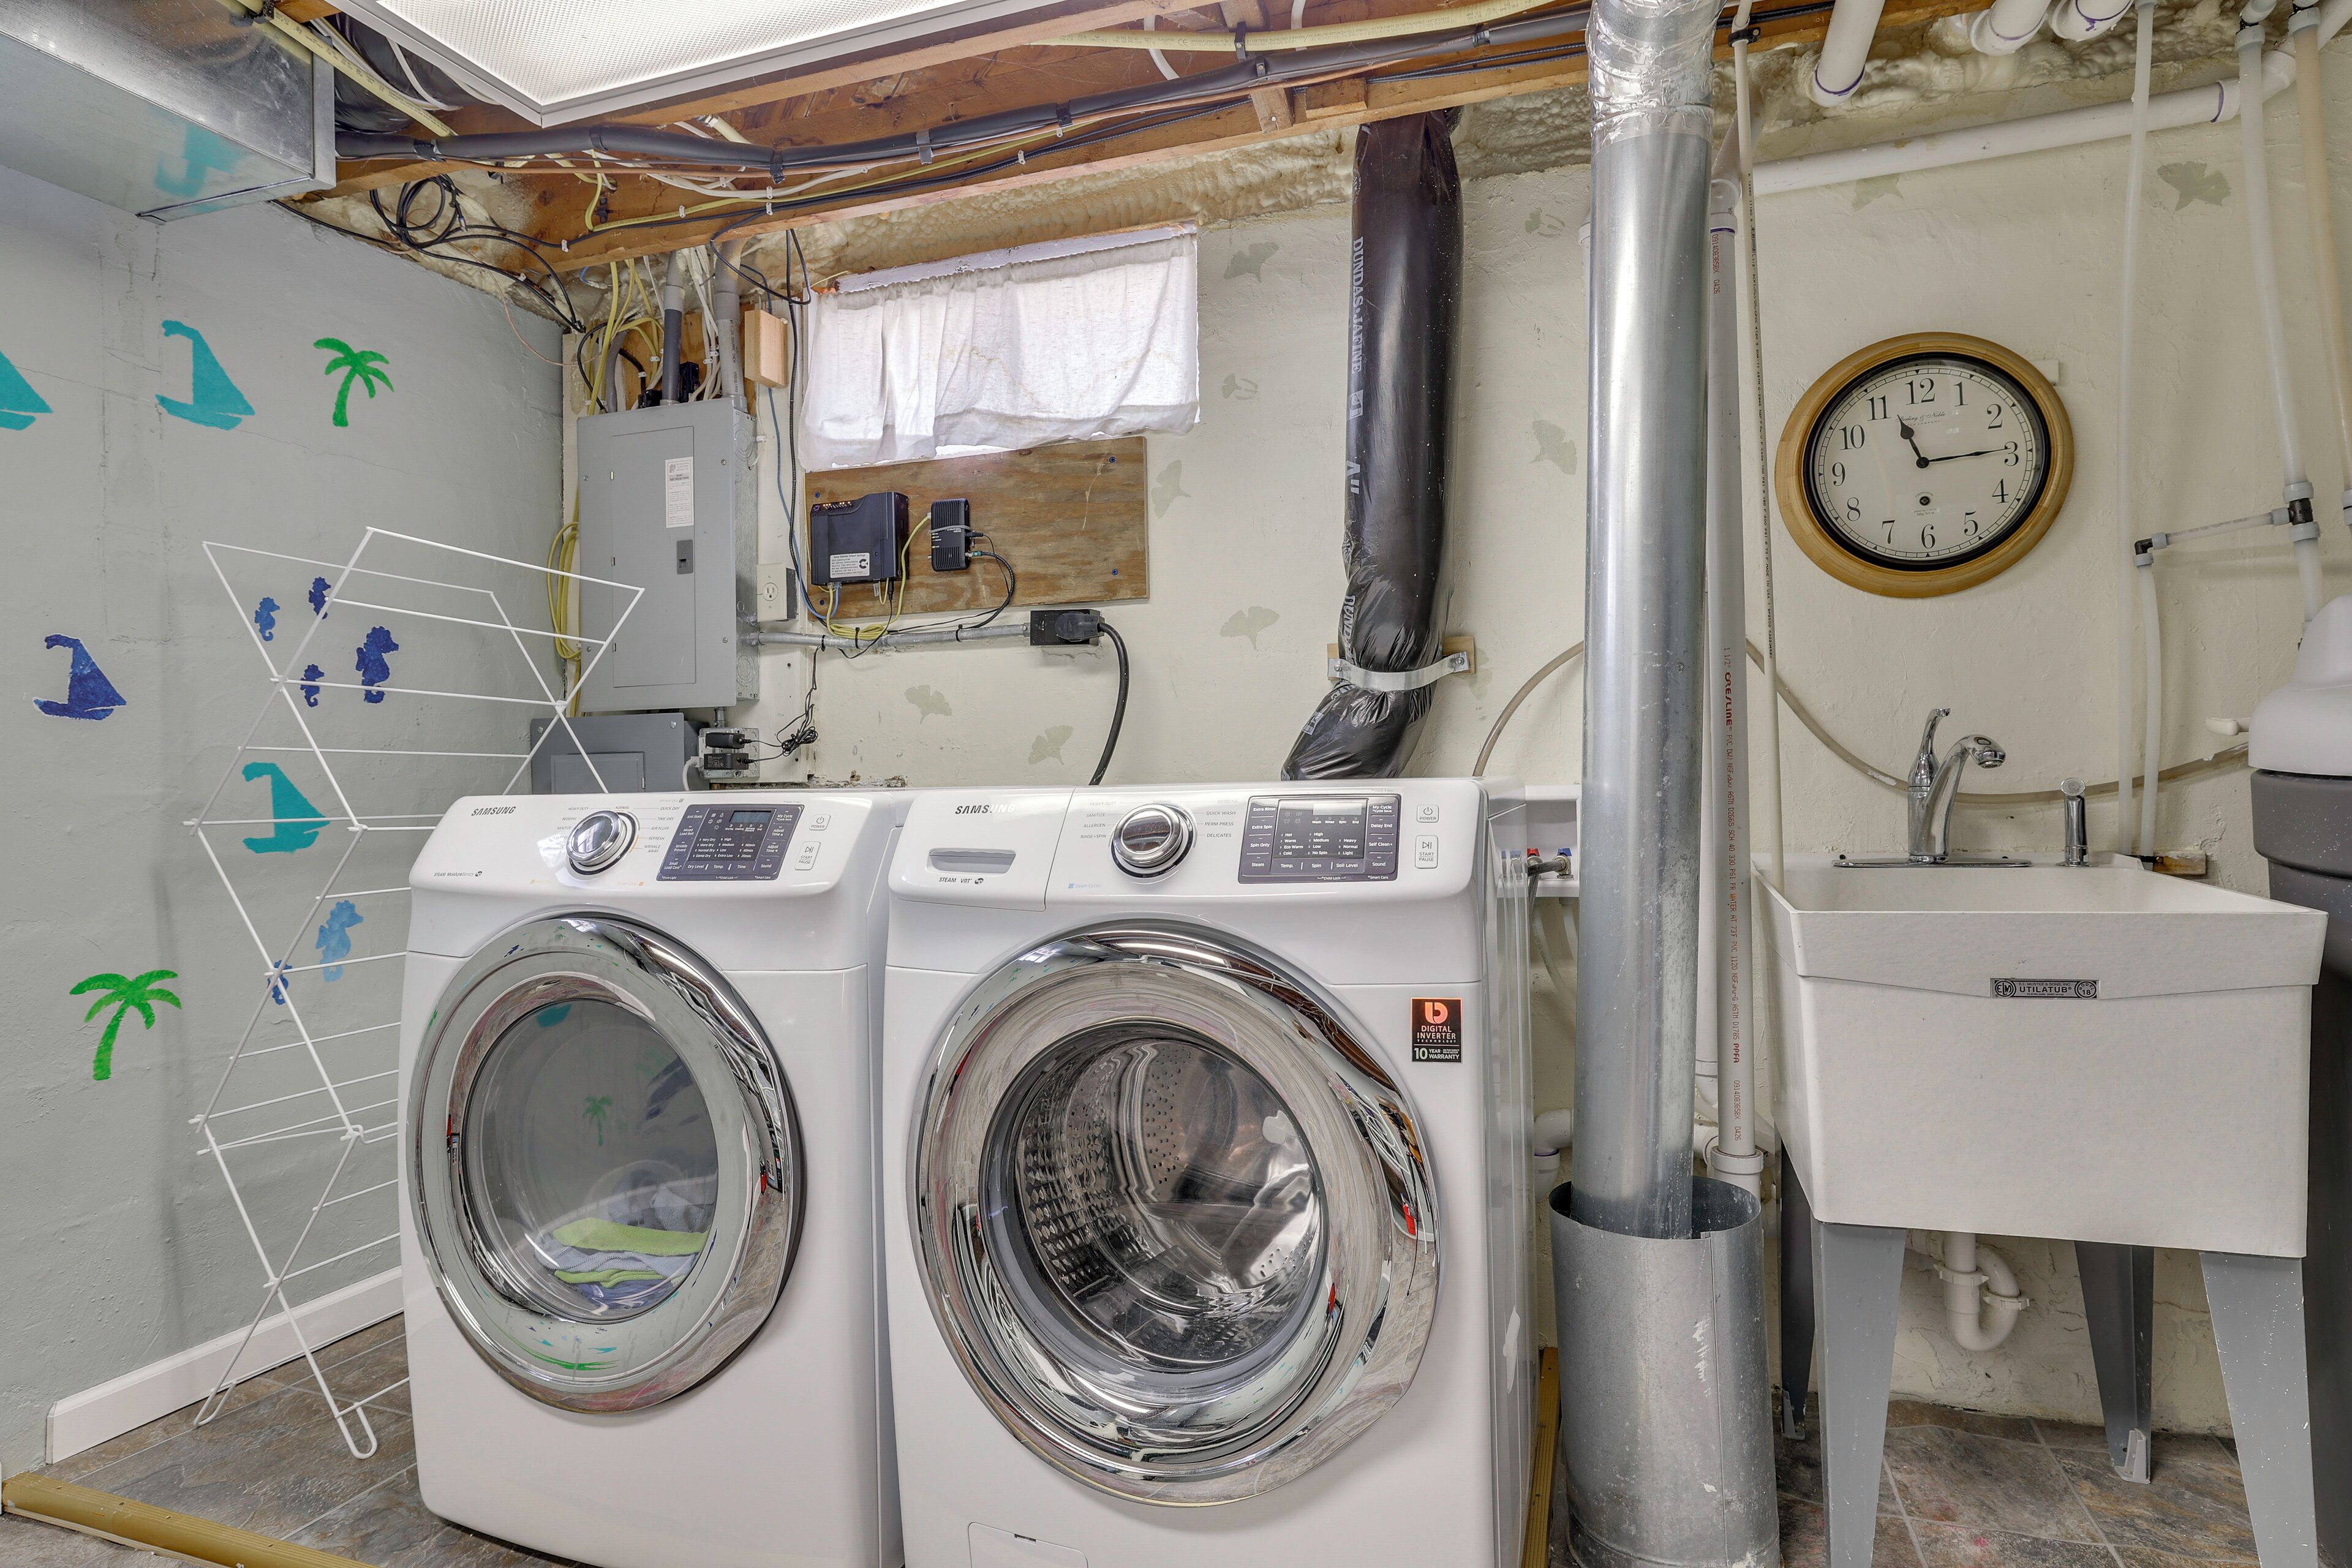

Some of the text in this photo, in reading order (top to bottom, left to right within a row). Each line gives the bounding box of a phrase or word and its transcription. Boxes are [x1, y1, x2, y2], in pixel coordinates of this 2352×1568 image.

[1905, 378, 1935, 405] 12
[1954, 381, 1968, 407] 1
[1866, 395, 1891, 421] 11
[1987, 404, 2002, 429] 2
[1839, 424, 1865, 450] 10
[2004, 441, 2019, 466] 3
[1832, 462, 1845, 486] 9
[1992, 479, 2009, 504] 4
[1847, 497, 1861, 521] 8
[1882, 520, 1895, 544] 7
[1964, 511, 1978, 536] 5
[1921, 524, 1936, 549] 6
[471, 806, 516, 816] SAMSUNG
[955, 804, 1016, 814] SAMSUNG
[1414, 1047, 1428, 1060] 10
